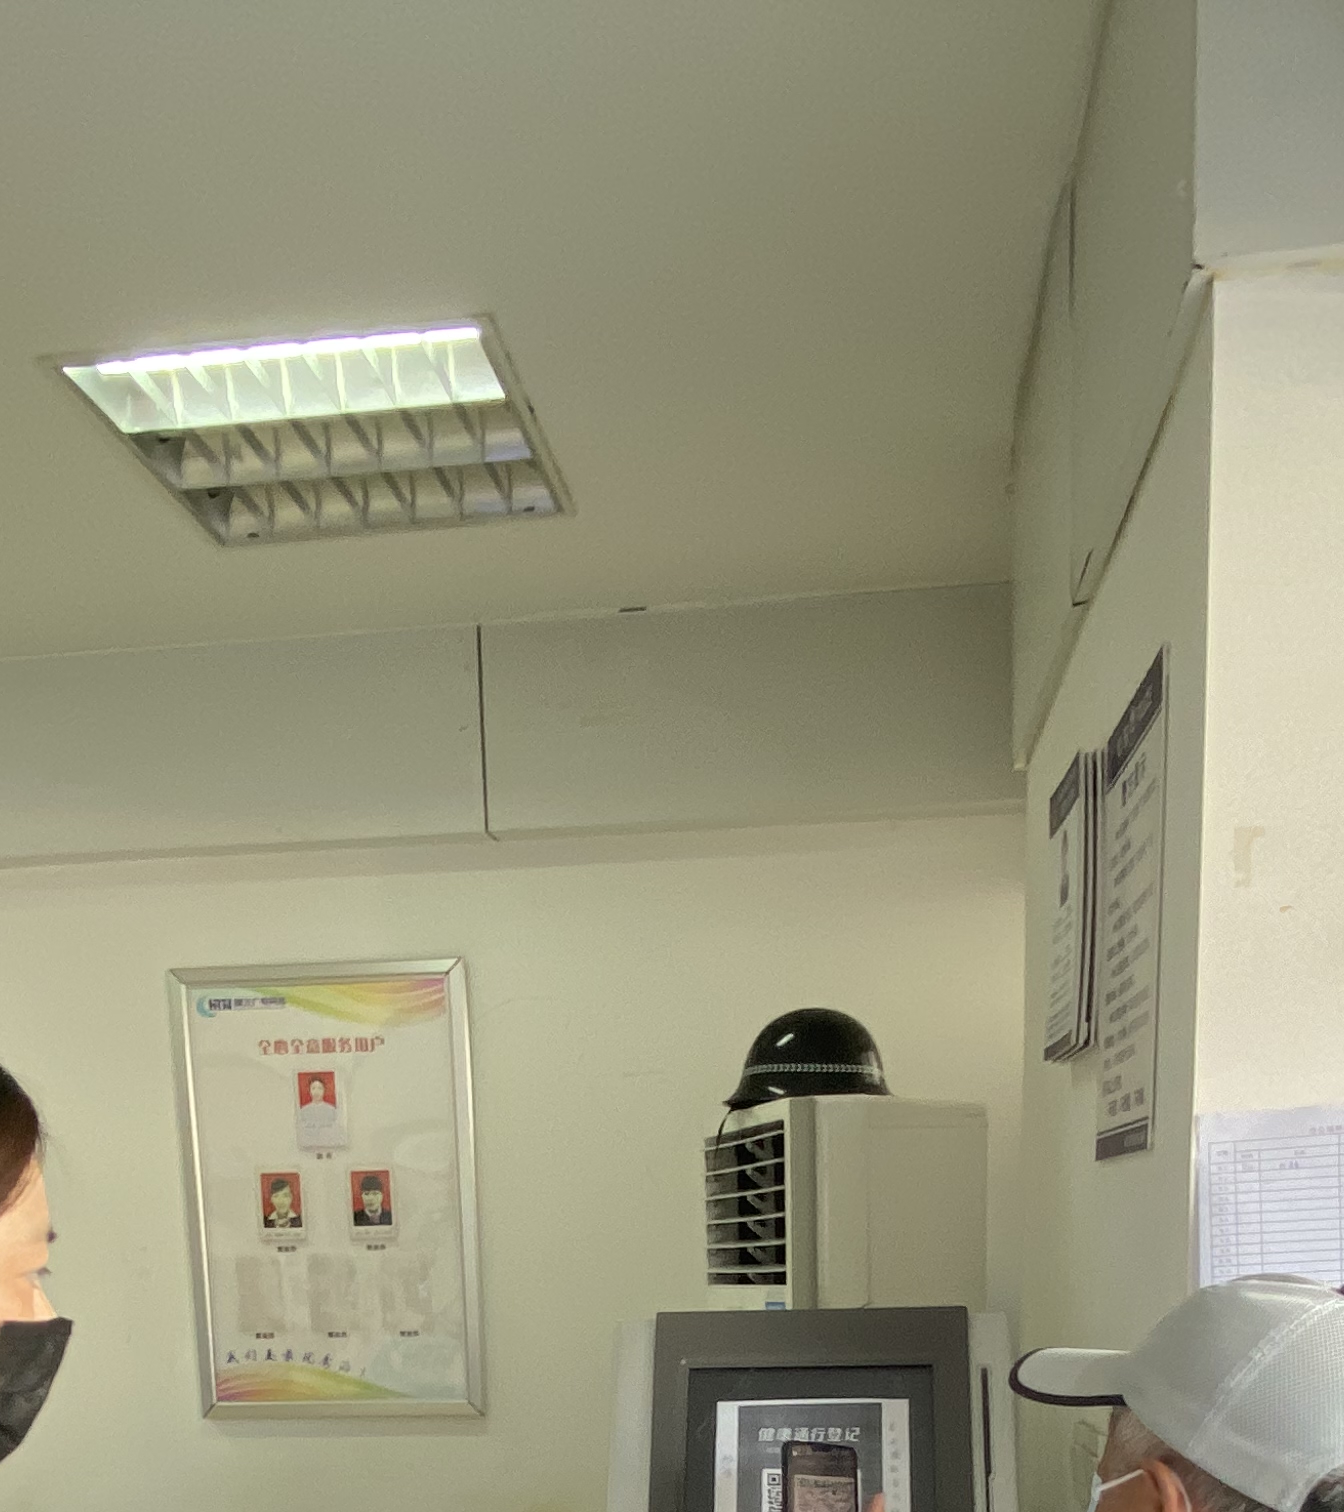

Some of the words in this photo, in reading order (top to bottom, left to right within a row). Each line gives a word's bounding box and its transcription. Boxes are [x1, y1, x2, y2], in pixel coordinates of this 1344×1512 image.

[258, 1036, 386, 1056] 全心全意服务用户
[758, 1427, 860, 1443] 健康通行登记
